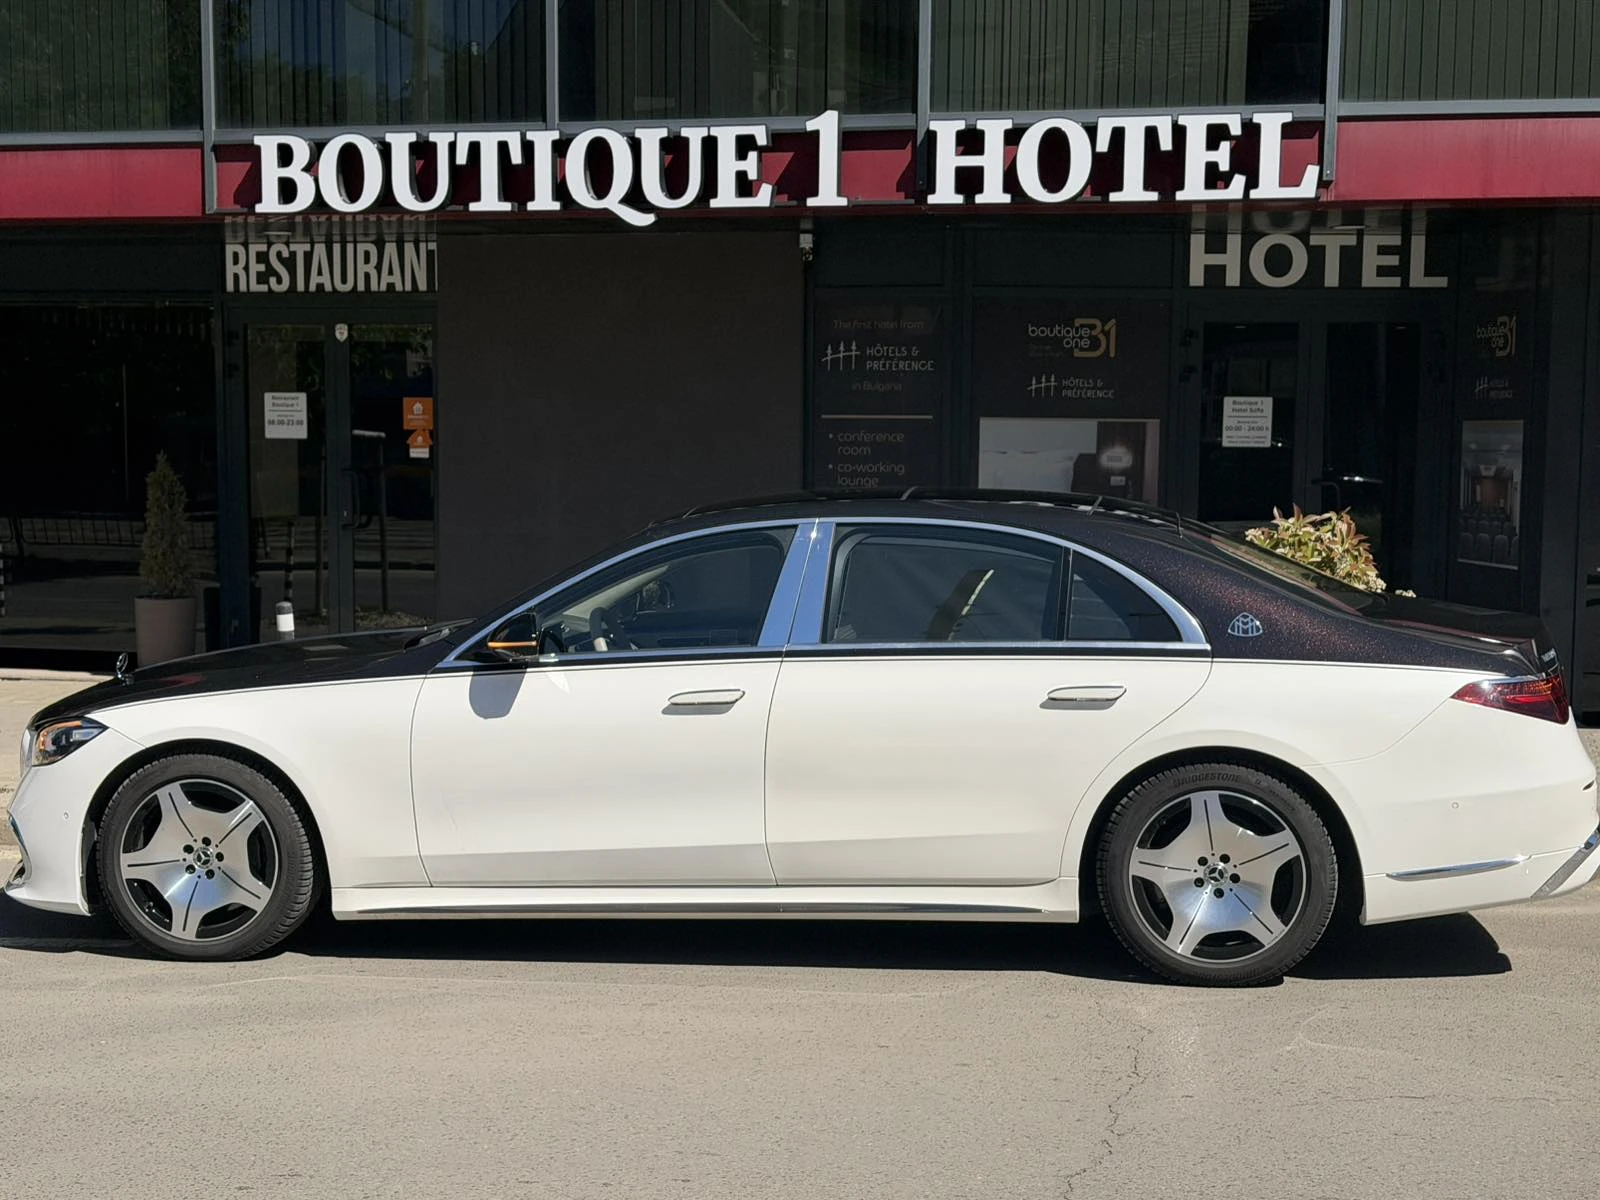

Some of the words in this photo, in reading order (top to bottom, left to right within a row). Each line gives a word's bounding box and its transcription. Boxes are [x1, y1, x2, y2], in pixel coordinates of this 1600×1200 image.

[253, 124, 775, 227] BOUTIQUE
[804, 109, 848, 206] 1
[927, 111, 1321, 205] HOTEL
[1188, 233, 1448, 288] HOTEL
[1027, 323, 1091, 338] boutique
[1063, 338, 1091, 348] one
[866, 344, 908, 357] HÔTELS
[911, 346, 920, 357] &
[866, 359, 935, 372] PRÉFÉRENCE
[837, 430, 905, 442] conference
[838, 445, 872, 456] room
[837, 462, 905, 476] co-working
[838, 474, 880, 488] lounge
